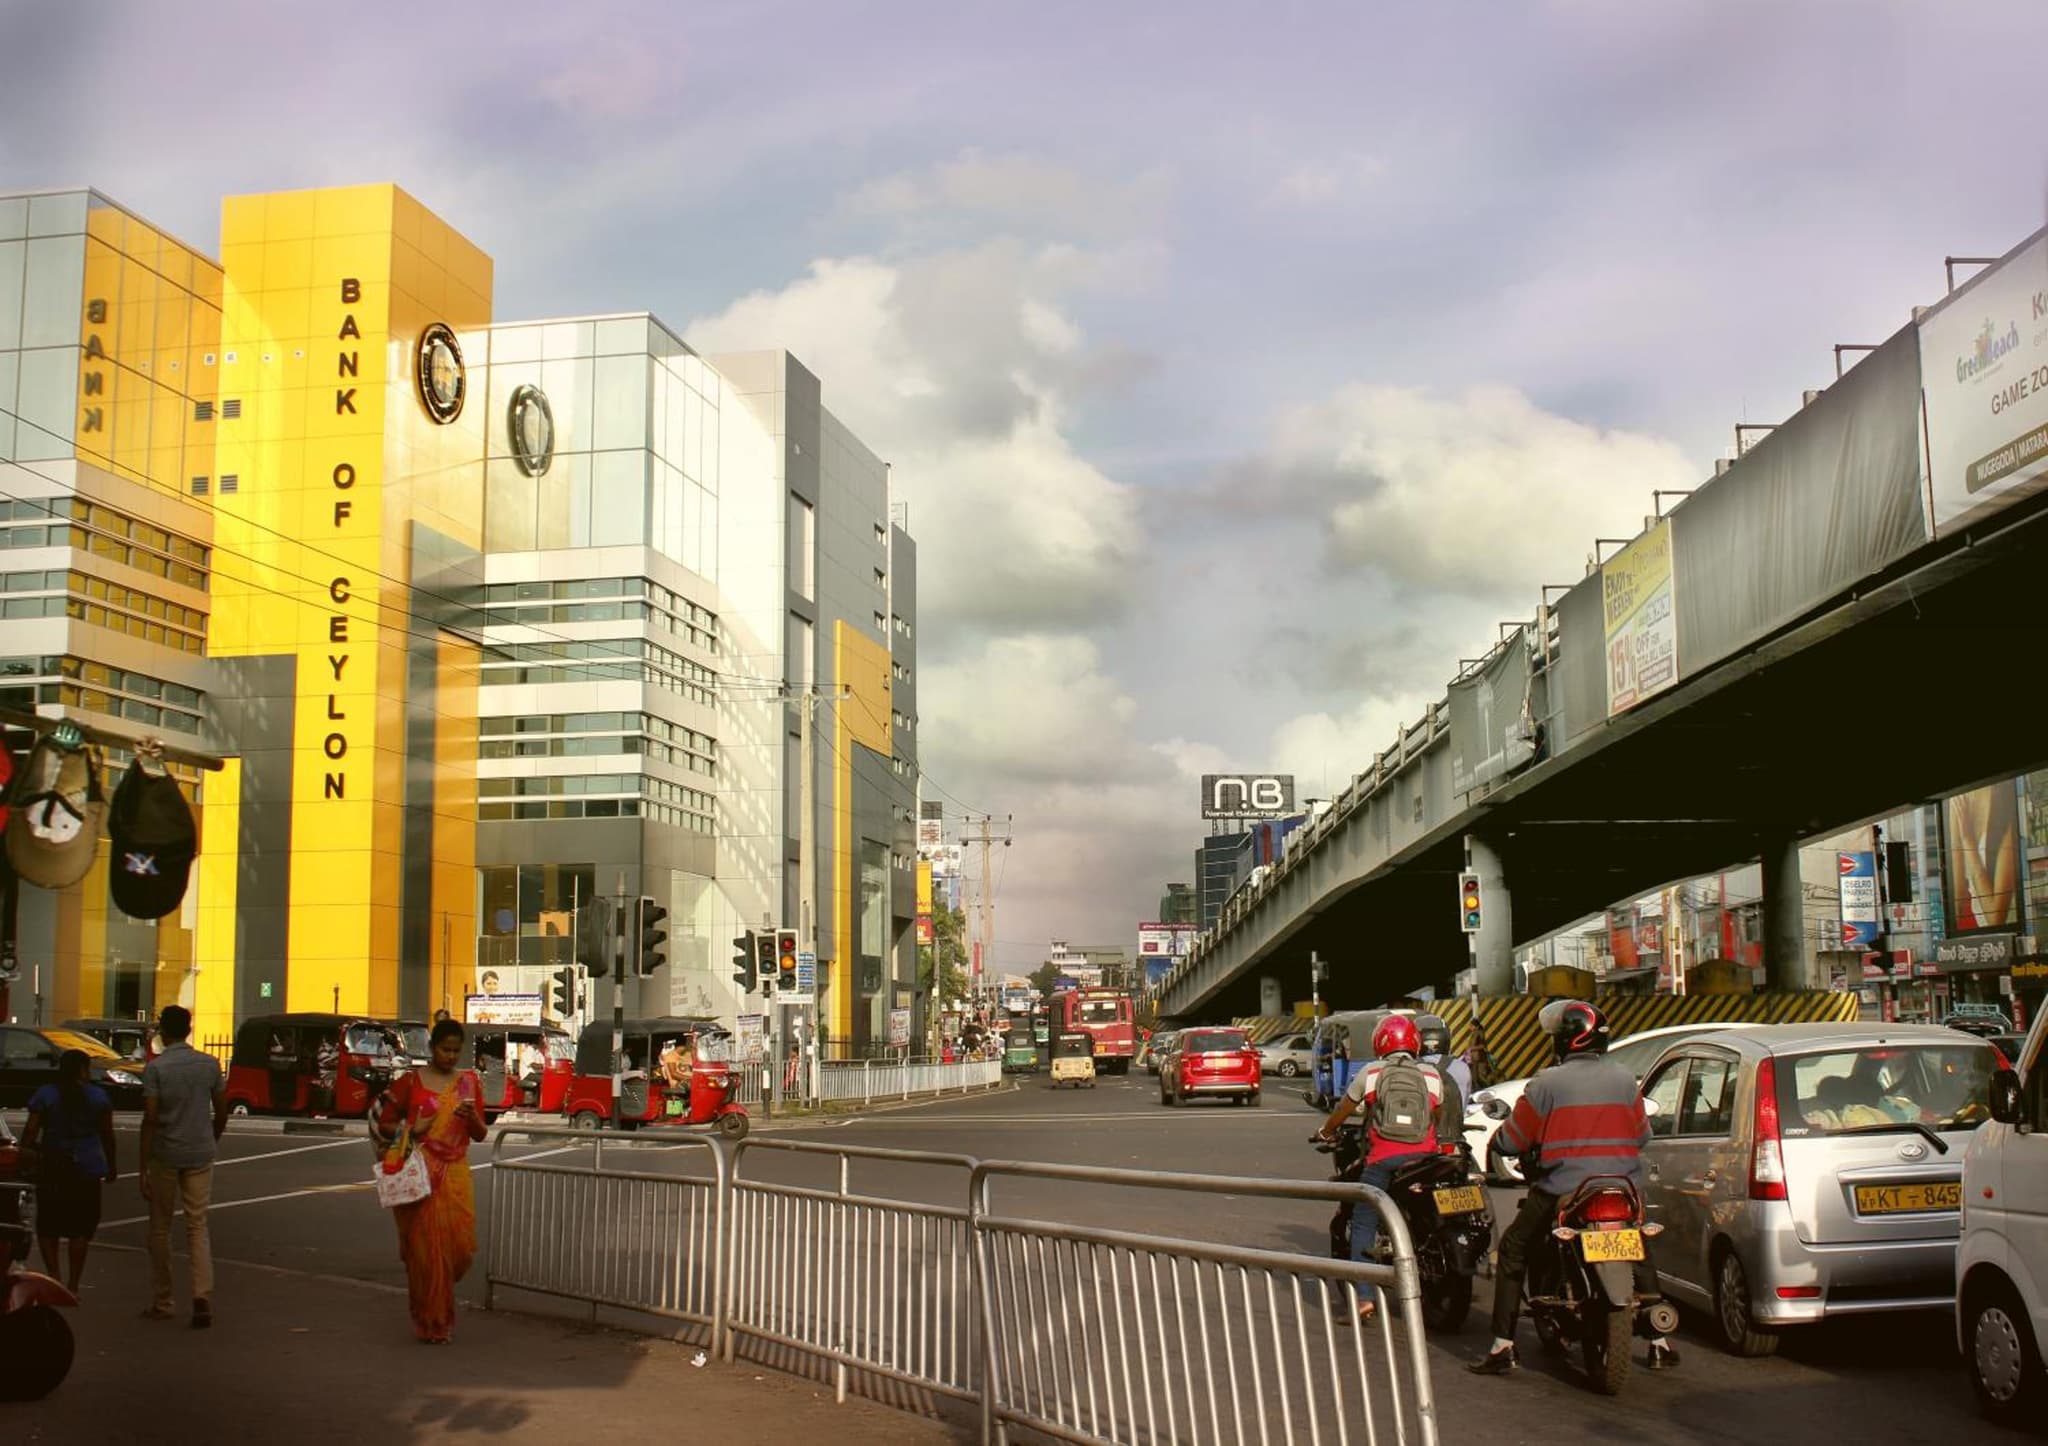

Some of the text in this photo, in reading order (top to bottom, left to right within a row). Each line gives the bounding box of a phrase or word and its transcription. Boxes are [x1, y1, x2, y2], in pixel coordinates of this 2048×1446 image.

[1991, 378, 2029, 415] GAME
[324, 278, 361, 799] BANK OF CEYLON
[1609, 634, 1637, 692] 15%
[1636, 629, 1650, 654] OFF
